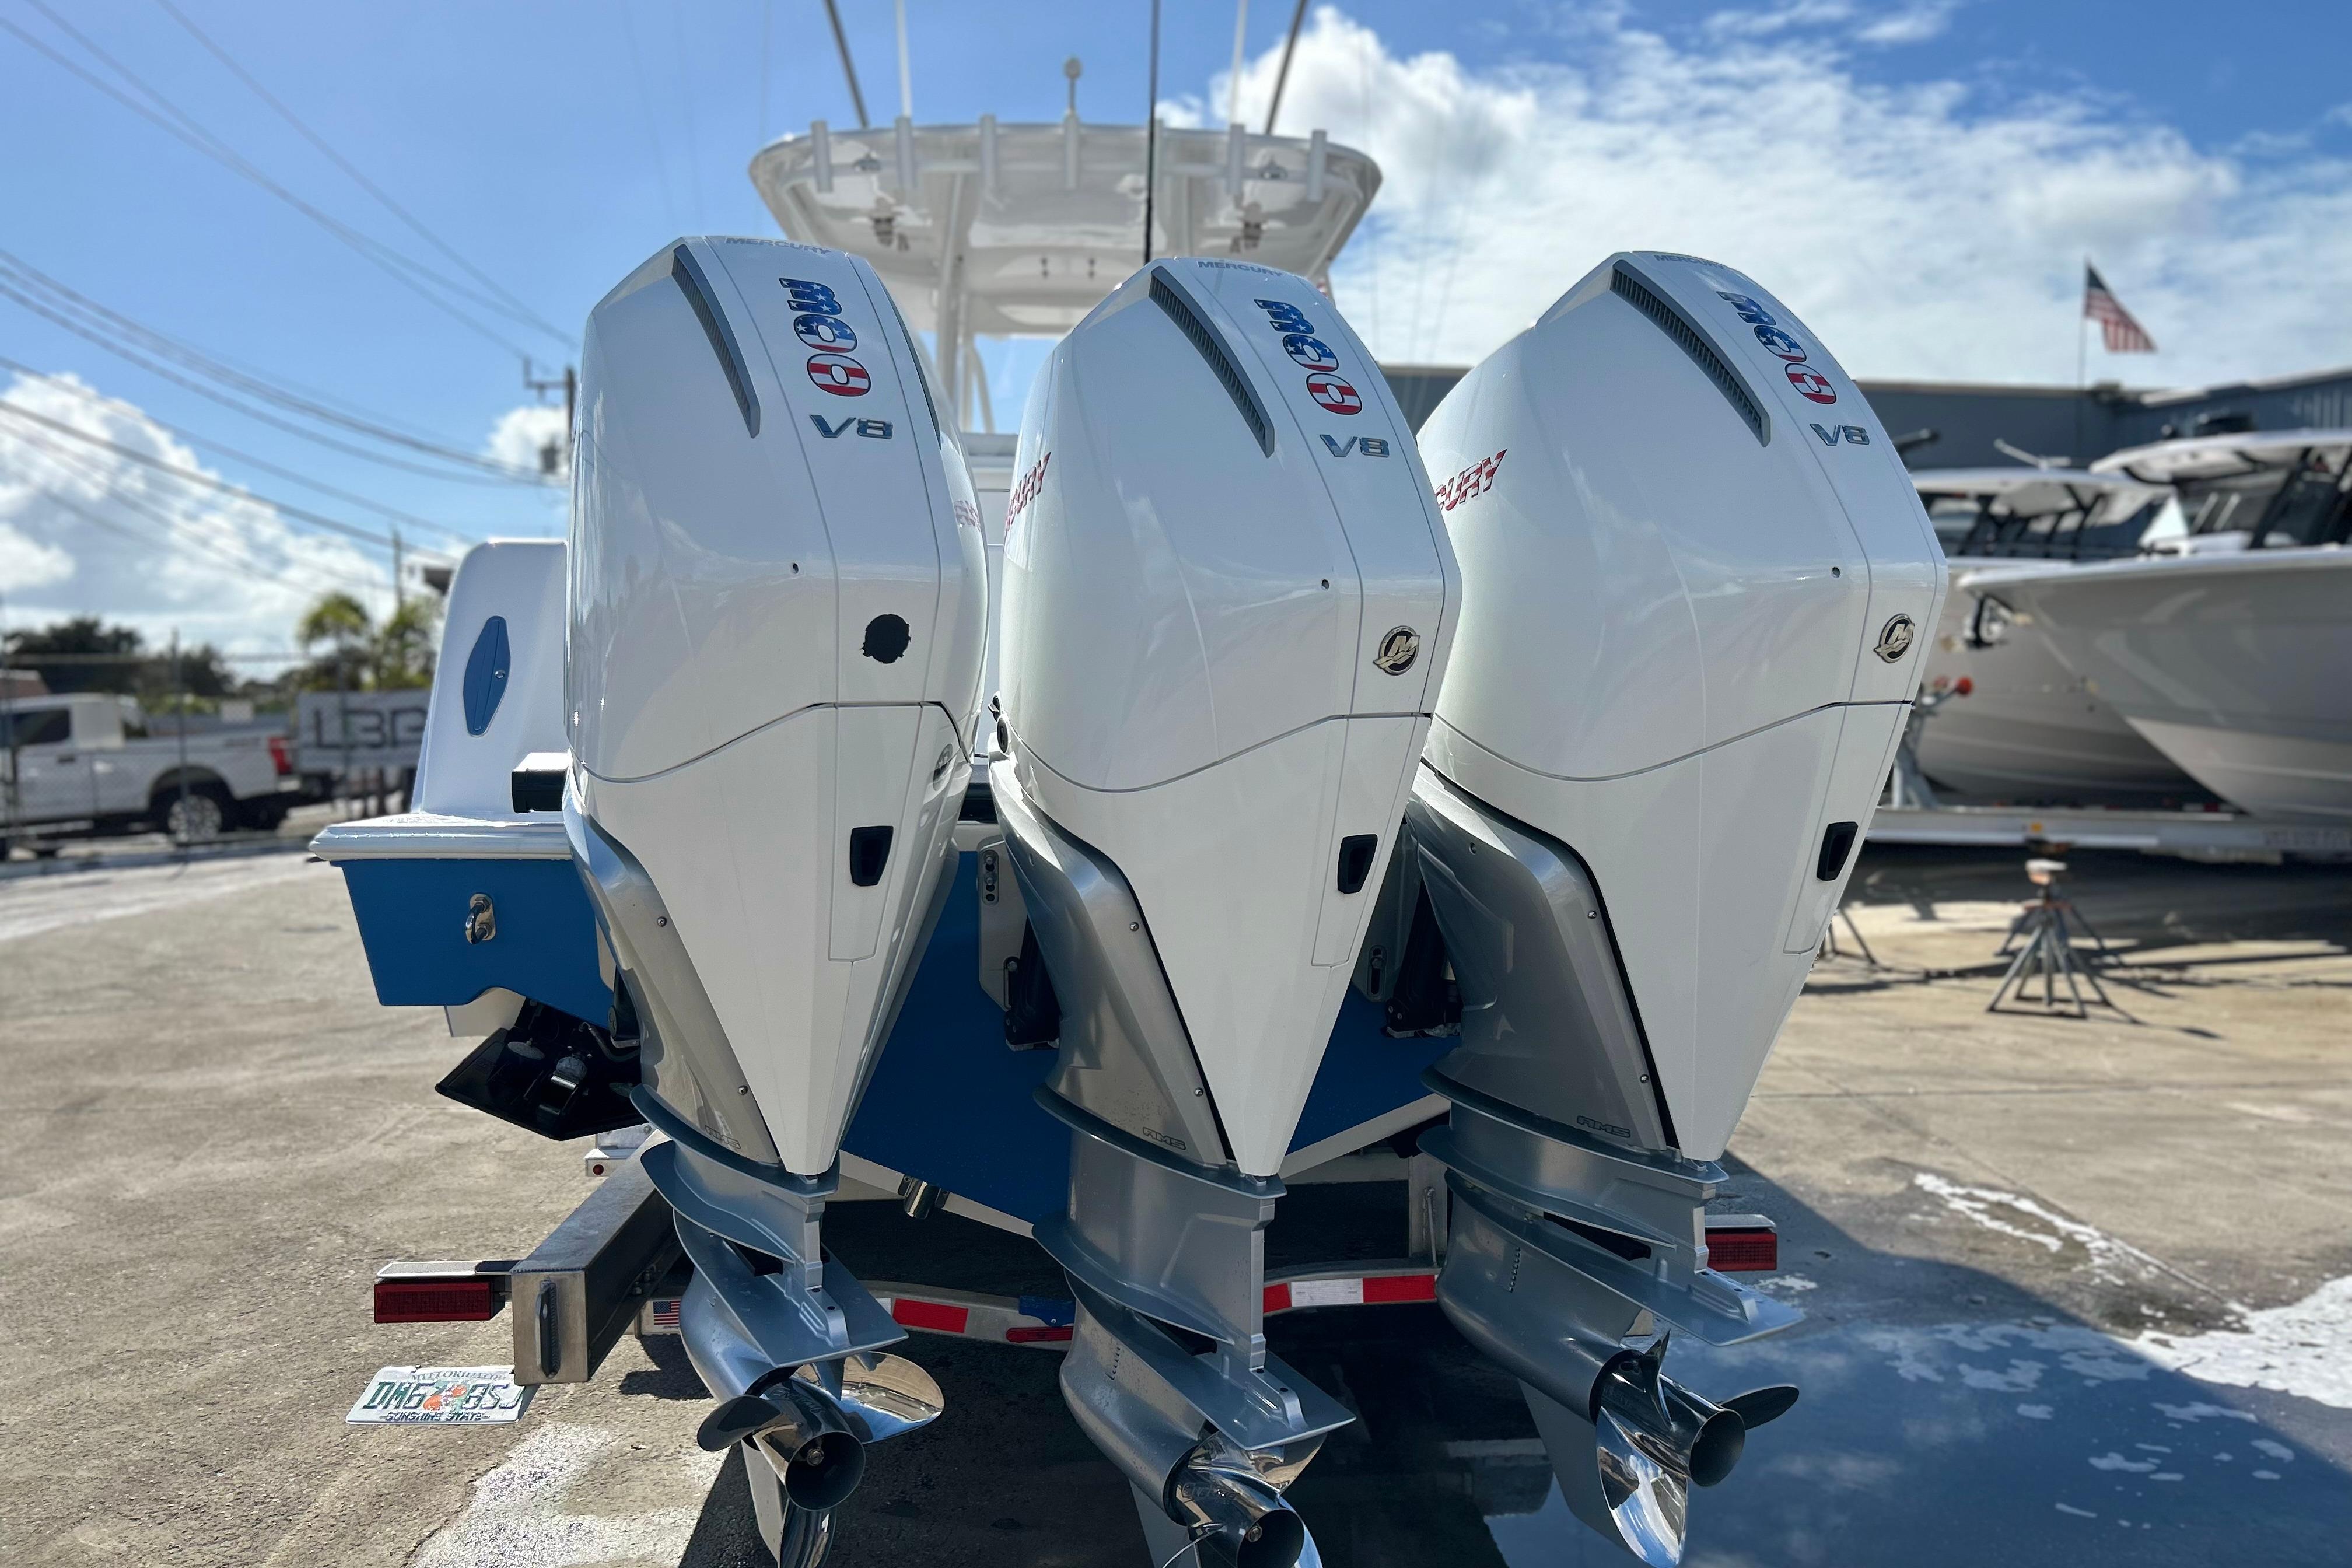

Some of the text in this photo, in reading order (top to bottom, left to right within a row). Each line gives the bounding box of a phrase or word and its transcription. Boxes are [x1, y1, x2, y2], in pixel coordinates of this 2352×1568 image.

[725, 237, 831, 254] MERCURY
[1198, 261, 1282, 277] MERCURY
[779, 278, 872, 396] 300
[1716, 290, 1837, 404] 300
[1254, 299, 1362, 415] 300
[809, 414, 894, 439] V8
[1810, 424, 1870, 446] V8
[1319, 434, 1390, 458] V8
[385, 1412, 485, 1422] SUNSHINE STATE
